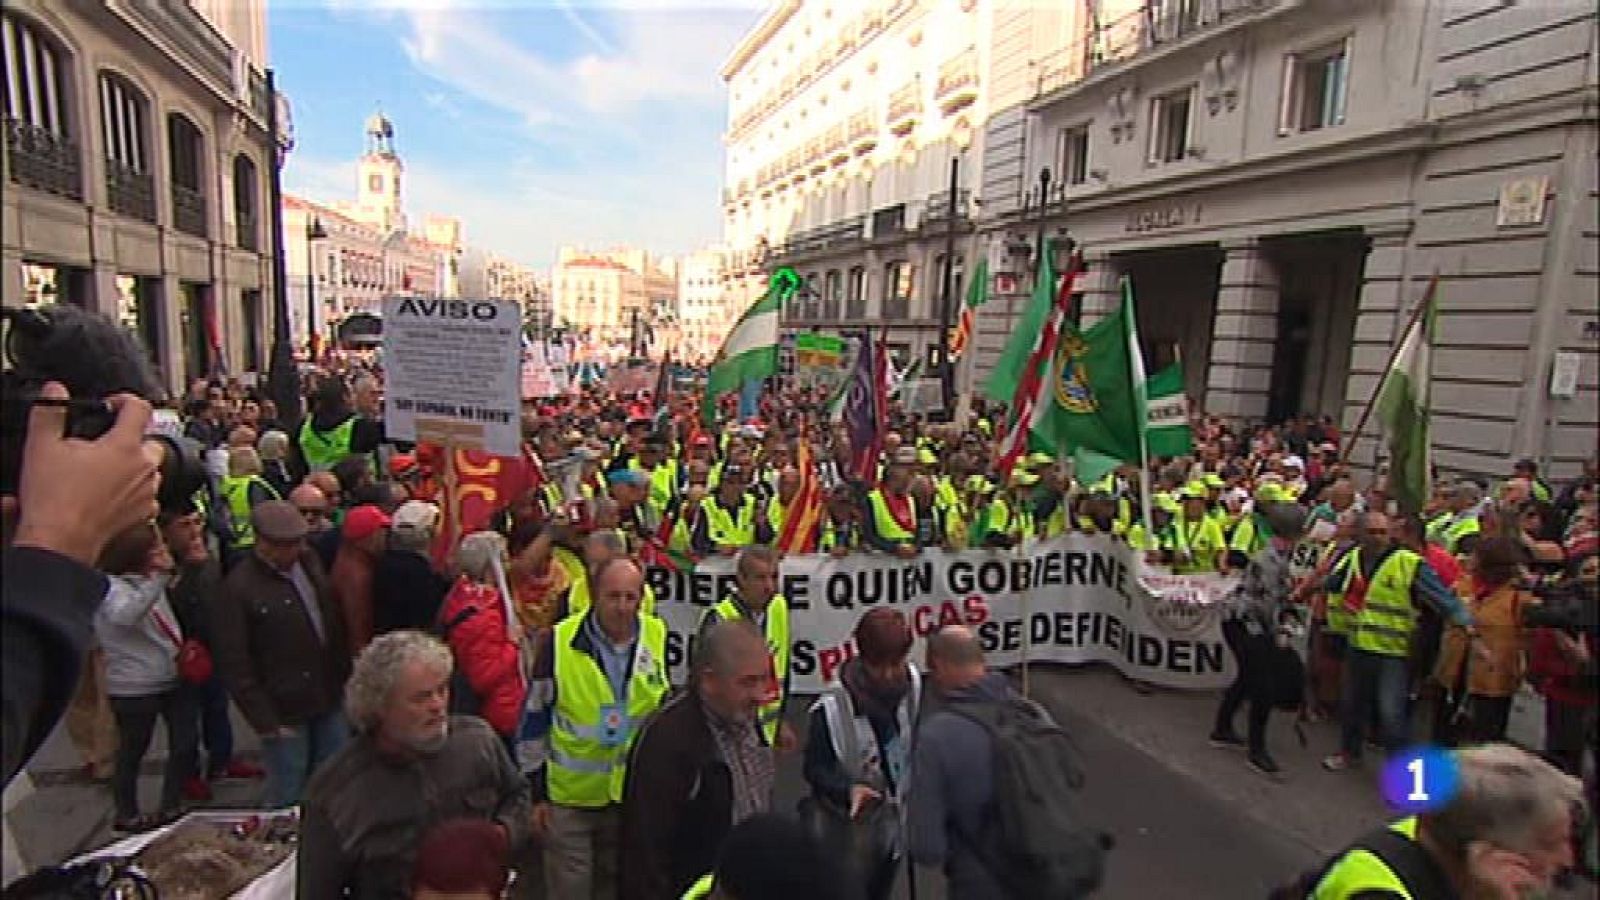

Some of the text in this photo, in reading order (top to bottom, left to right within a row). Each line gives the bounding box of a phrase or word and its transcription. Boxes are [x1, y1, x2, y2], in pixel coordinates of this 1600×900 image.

[398, 299, 498, 320] AVISO
[647, 566, 810, 610] BIERE
[826, 561, 933, 610] QUIEN
[978, 619, 1023, 651] SE
